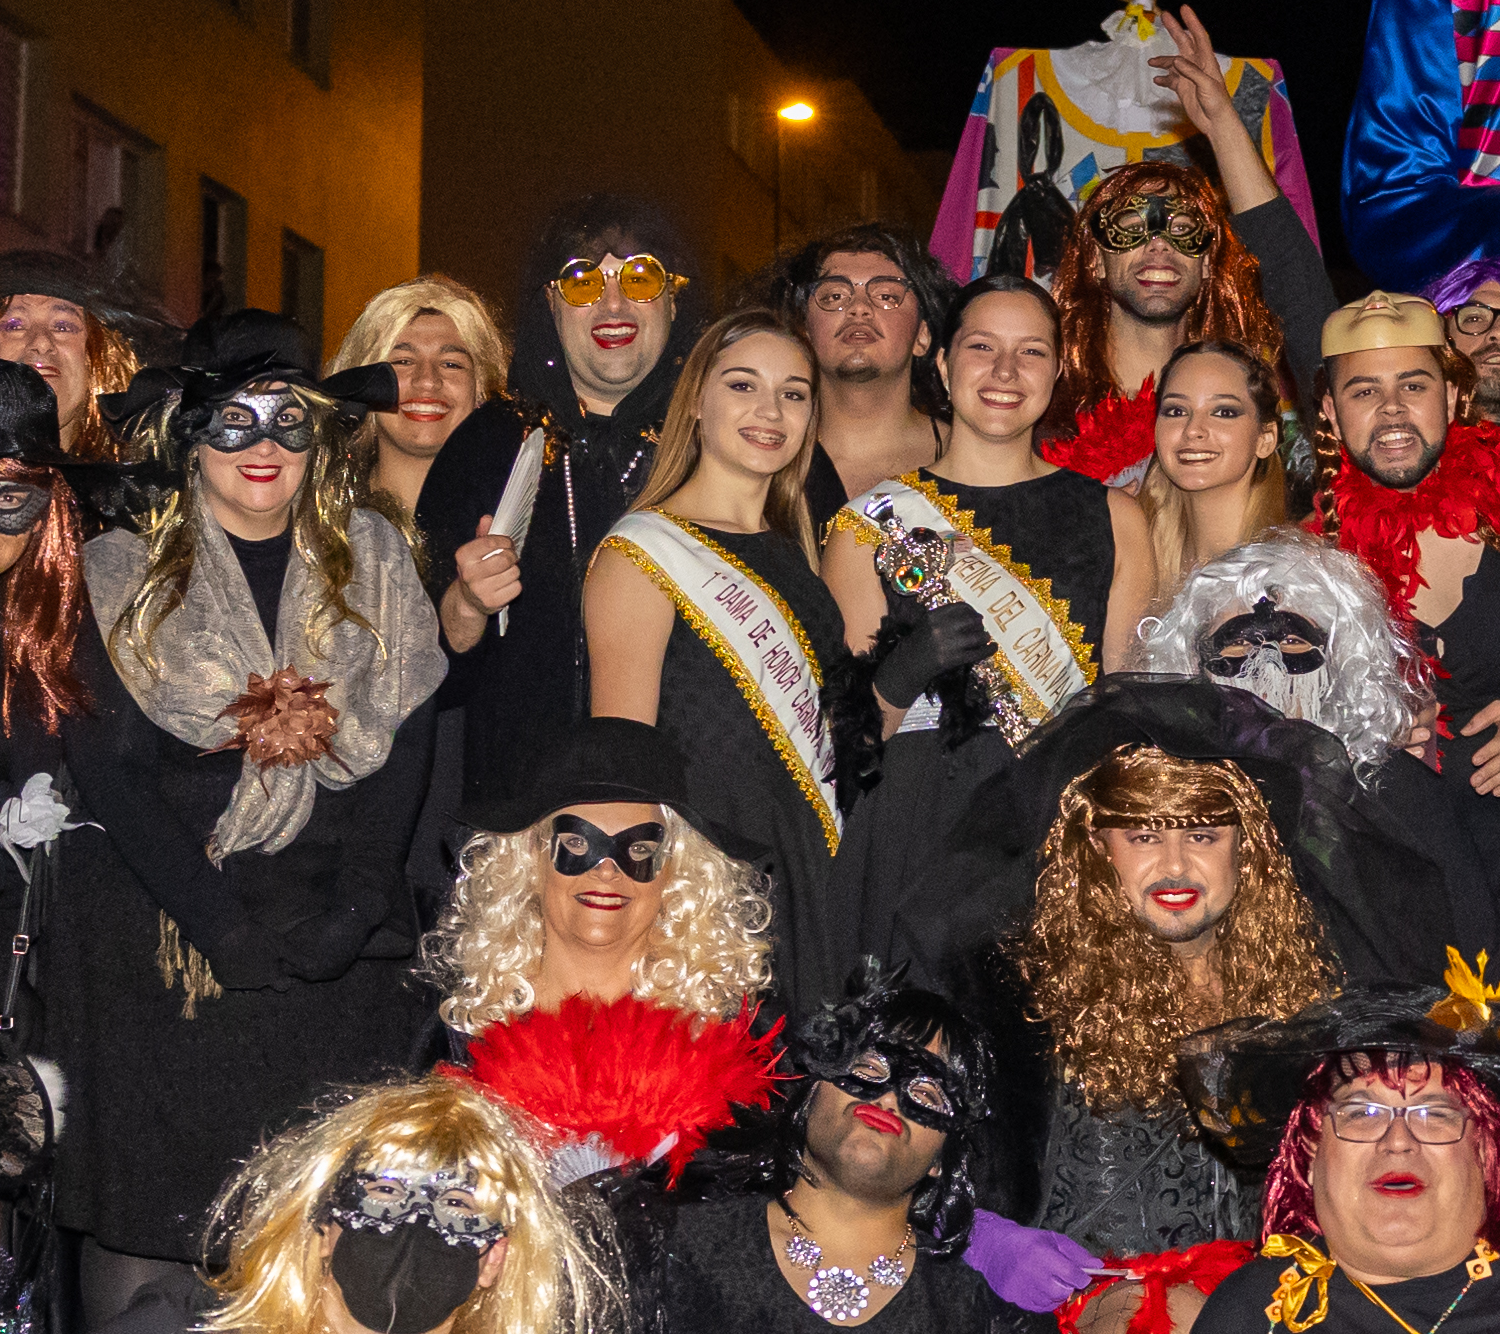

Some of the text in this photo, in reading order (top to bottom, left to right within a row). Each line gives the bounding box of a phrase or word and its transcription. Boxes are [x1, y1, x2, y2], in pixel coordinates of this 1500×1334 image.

[714, 583, 759, 626] DAMA
[747, 618, 777, 649] DE
[952, 555, 1074, 708] REINA DEL CARNAVAL
[761, 641, 802, 694] HONOR
